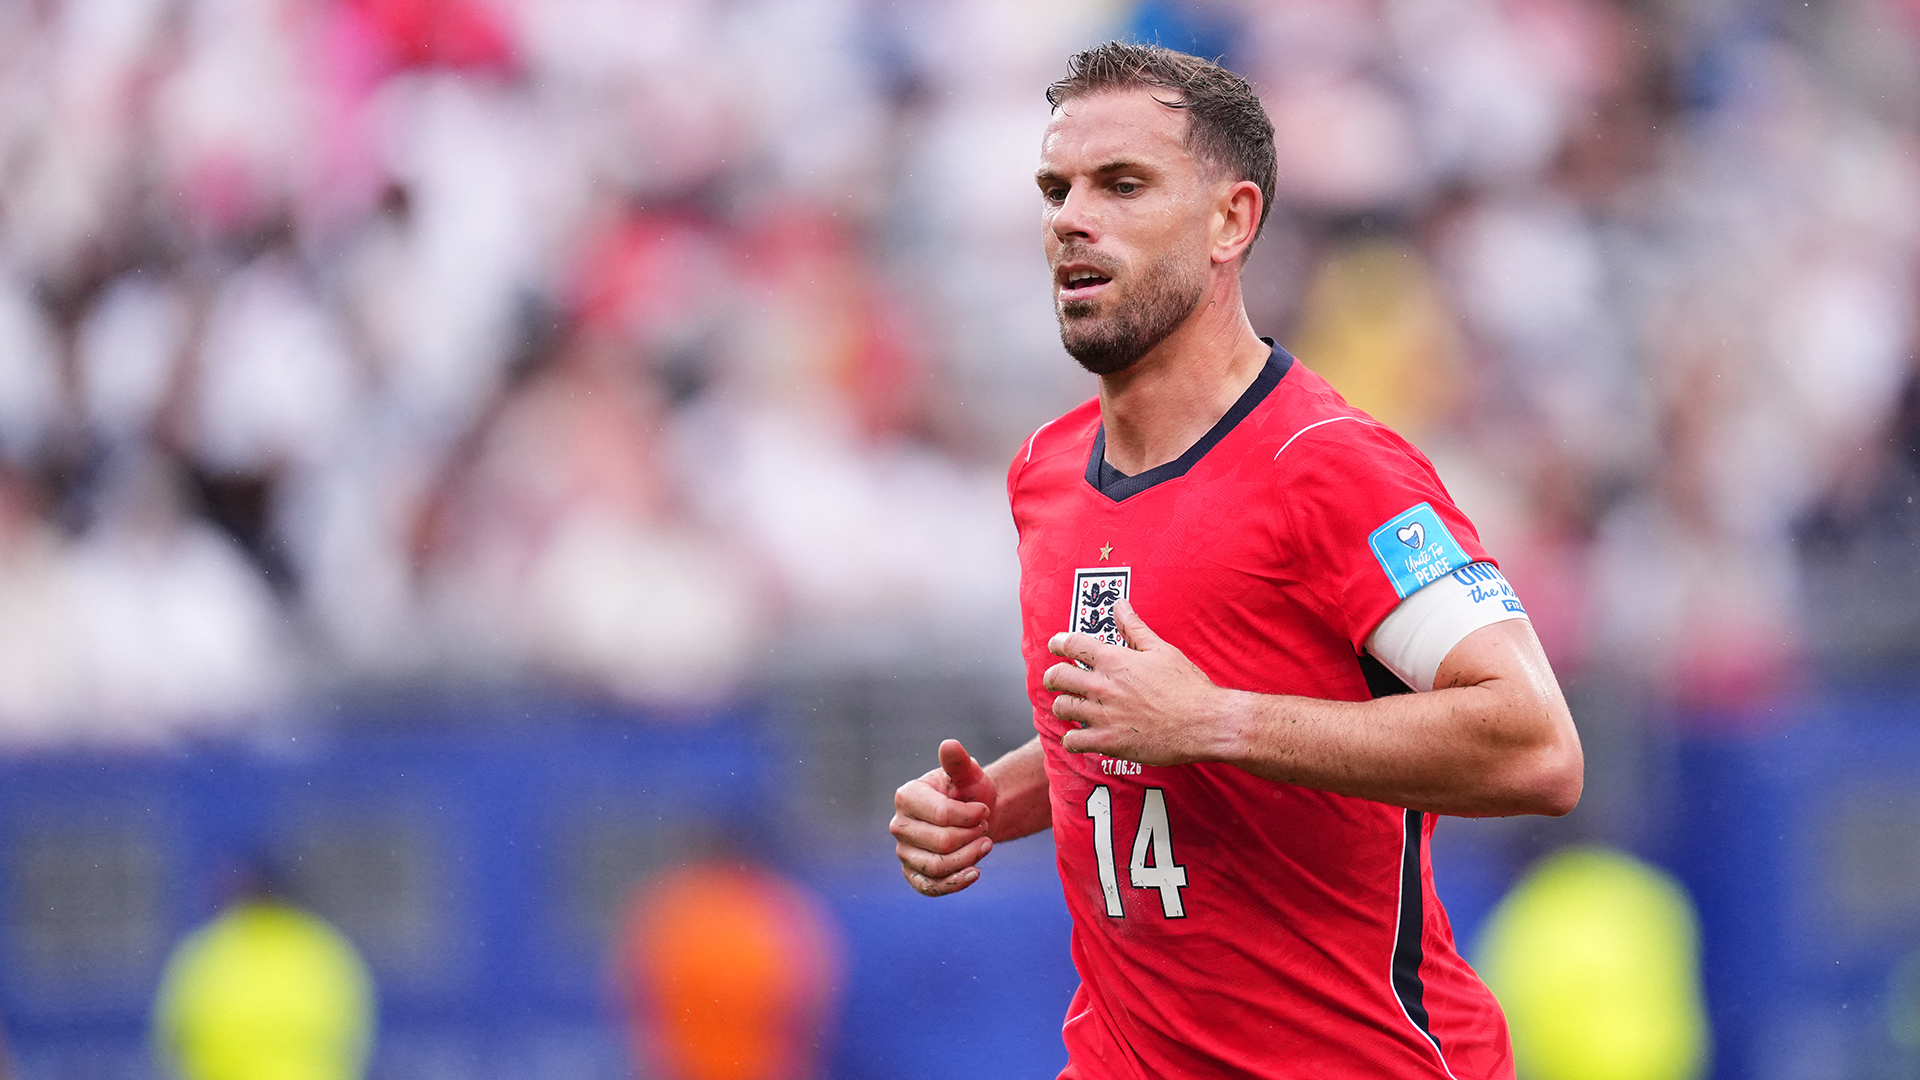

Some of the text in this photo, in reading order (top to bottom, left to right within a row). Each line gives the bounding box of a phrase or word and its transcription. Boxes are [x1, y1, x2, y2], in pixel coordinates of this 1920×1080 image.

[1405, 542, 1444, 573] Unite For
[1414, 556, 1453, 587] PEACE
[1466, 585, 1499, 603] the
[1101, 760, 1142, 775] 27.06.26
[1086, 784, 1189, 919] 14
